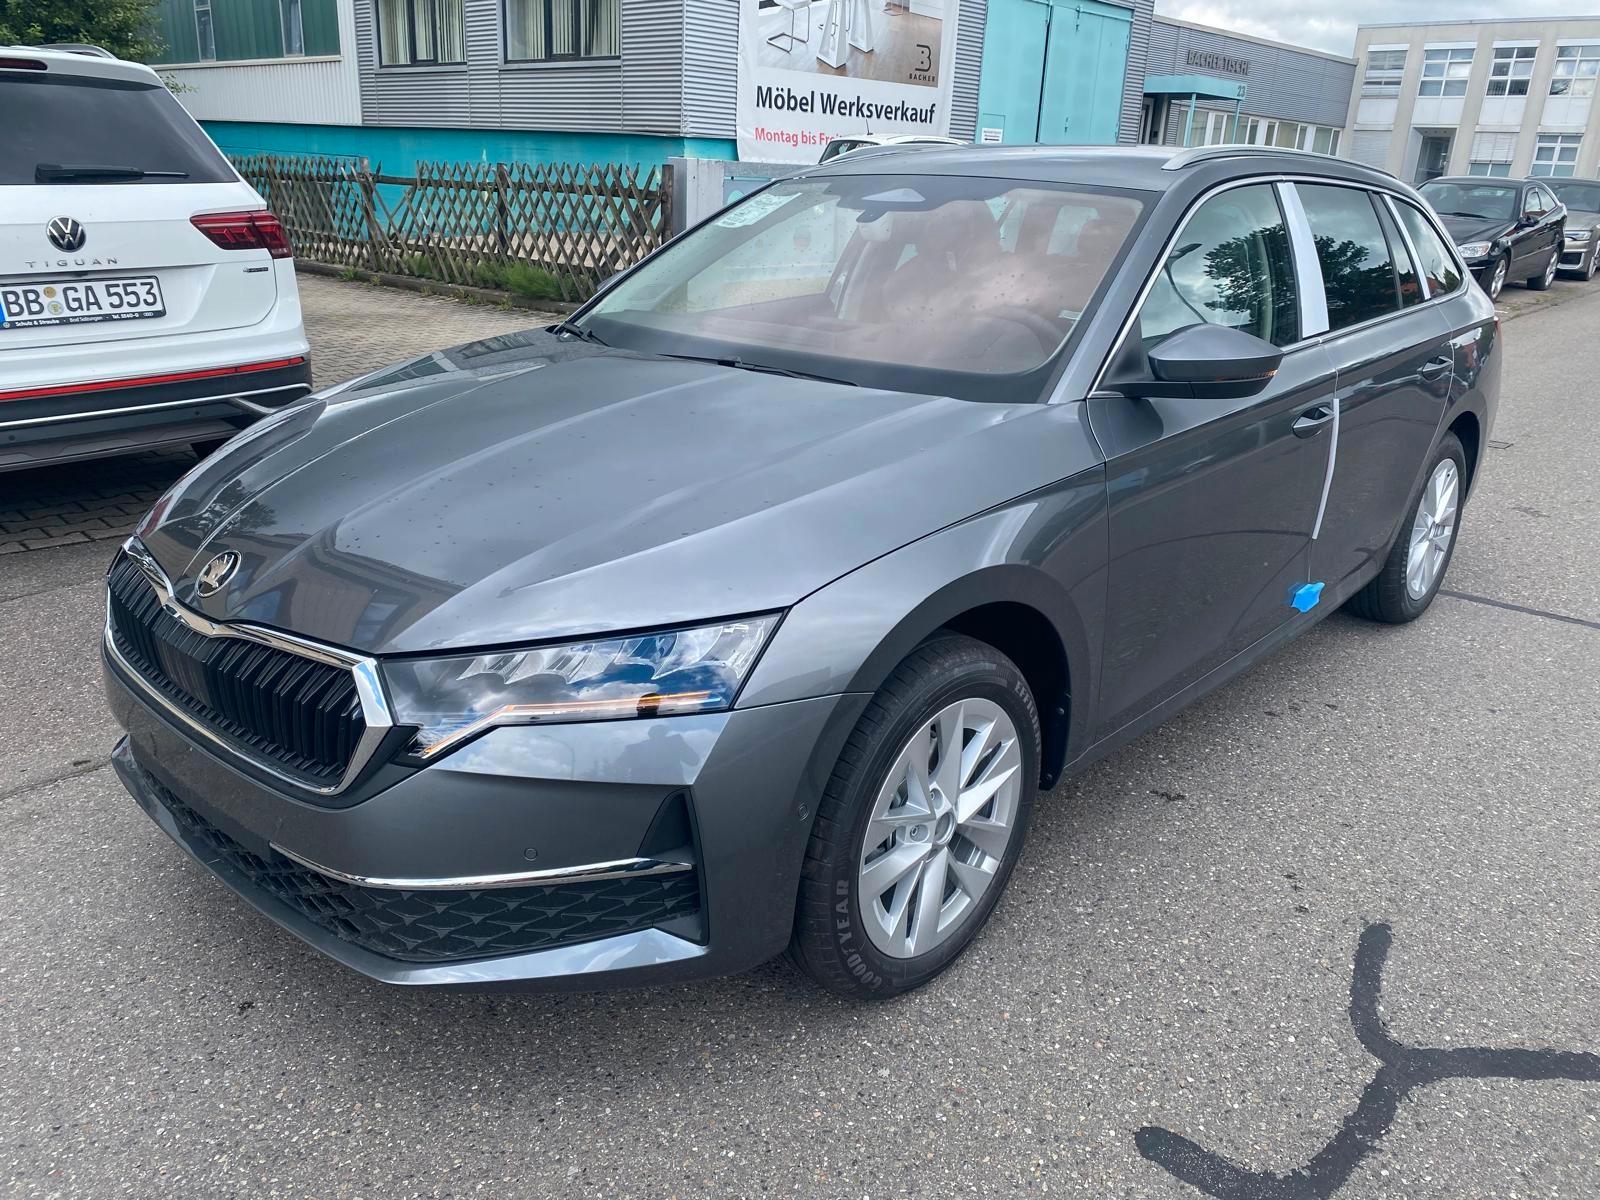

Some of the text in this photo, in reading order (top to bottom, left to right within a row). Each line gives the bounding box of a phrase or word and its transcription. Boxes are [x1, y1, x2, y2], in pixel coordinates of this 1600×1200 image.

[909, 73, 936, 82] BACHER
[1237, 85, 1246, 97] 23
[756, 85, 936, 125] Möbel Werksverkauf
[755, 127, 798, 147] Montag
[801, 131, 817, 145] bis
[25, 257, 118, 269] TIGUAN
[1, 281, 158, 318] BB GA 553
[836, 879, 882, 989] GOODYEAR
